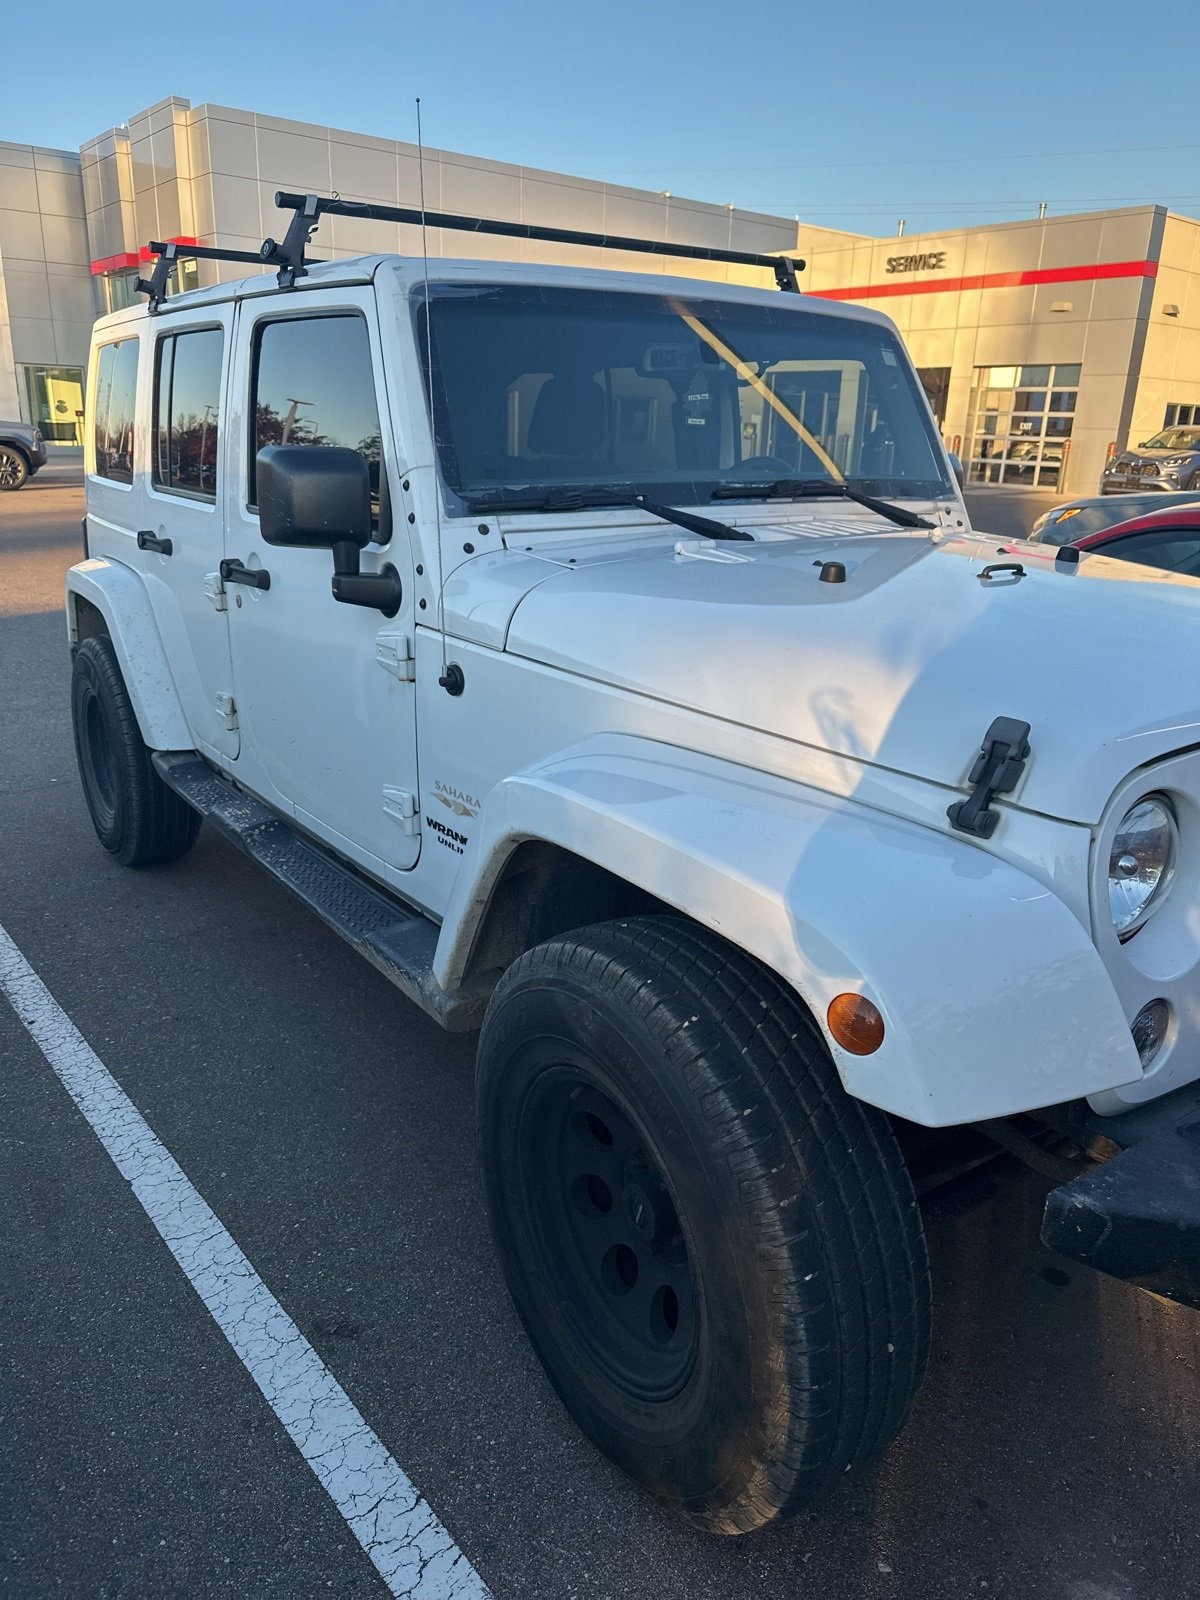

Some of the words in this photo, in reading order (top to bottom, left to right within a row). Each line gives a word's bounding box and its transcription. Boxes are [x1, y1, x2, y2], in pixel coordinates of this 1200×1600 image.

[886, 252, 947, 274] SERVICE
[1020, 422, 1032, 430] EXIT
[434, 780, 481, 809] SAHARA
